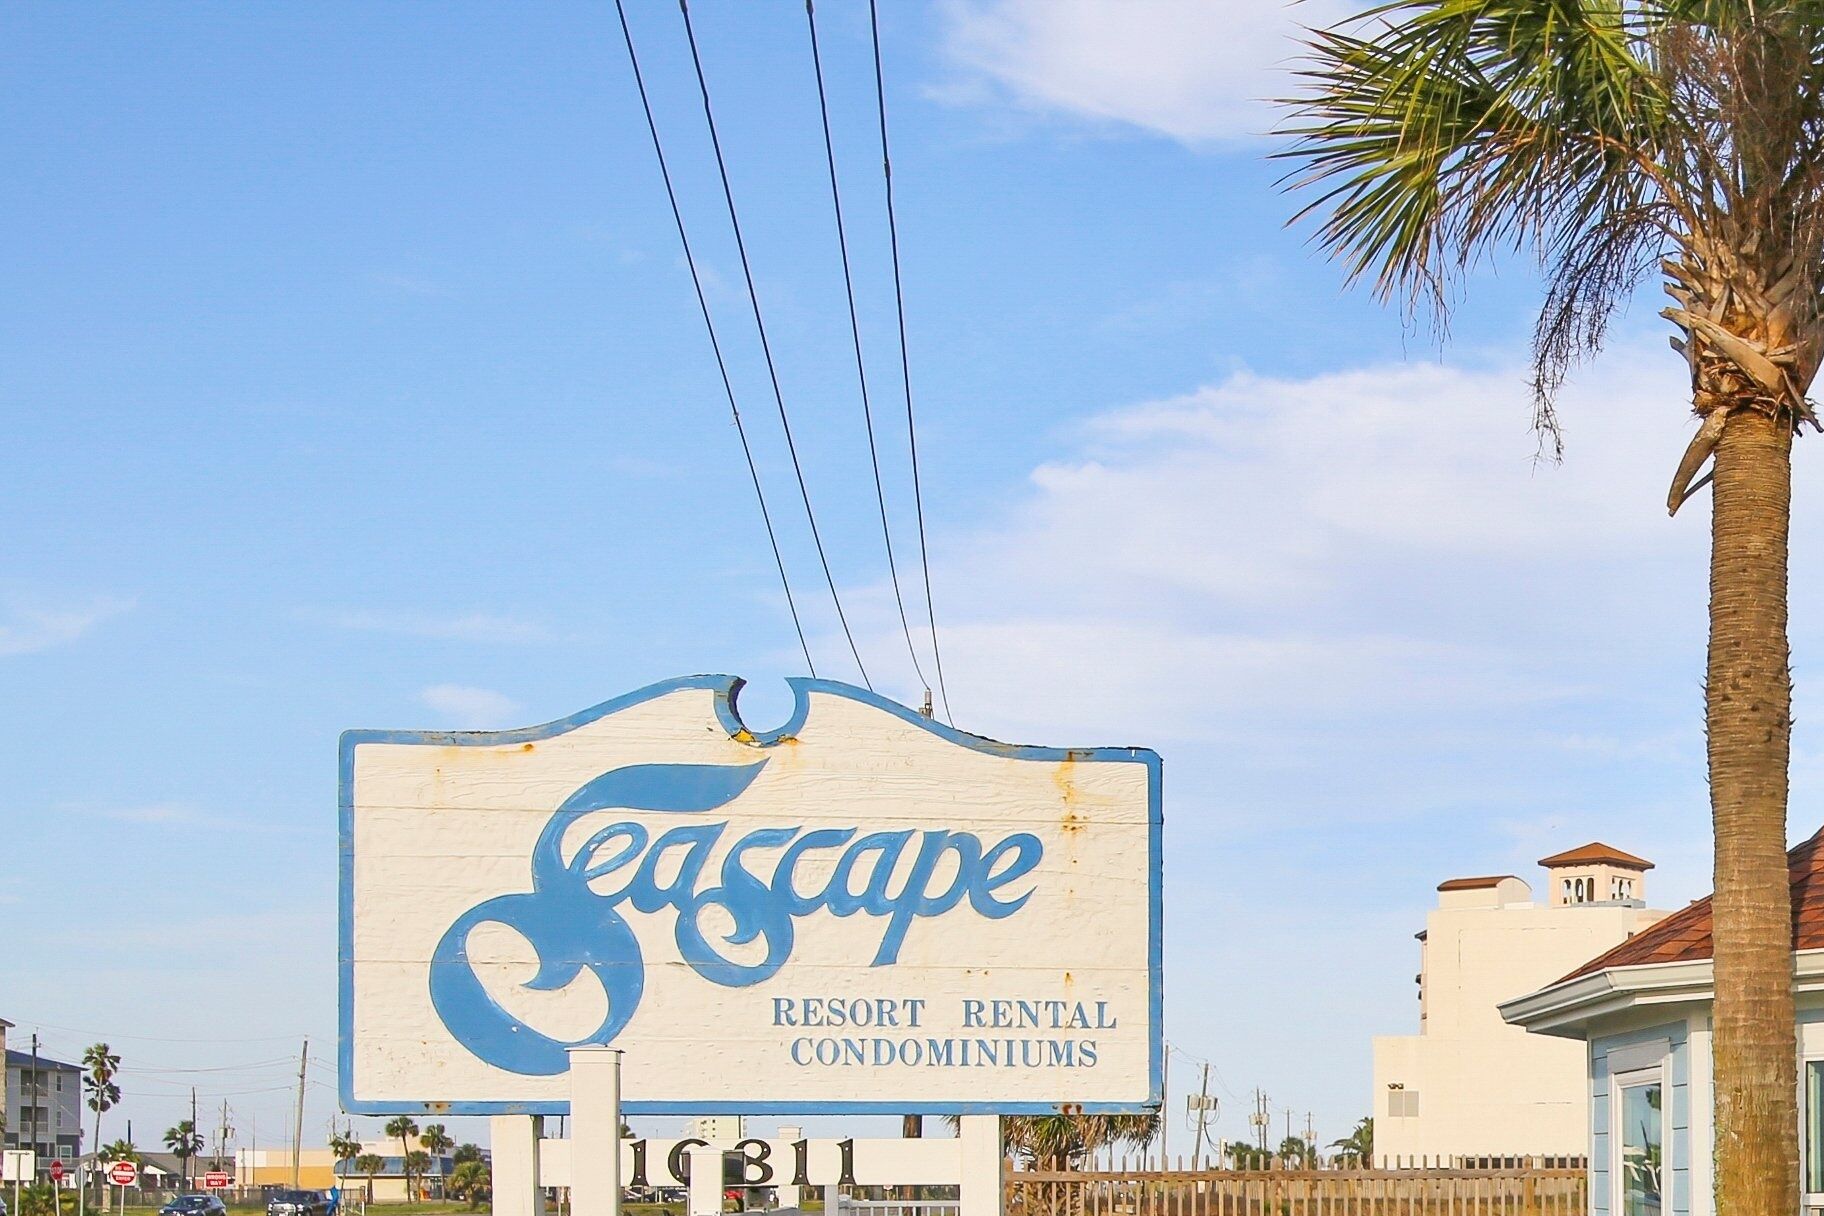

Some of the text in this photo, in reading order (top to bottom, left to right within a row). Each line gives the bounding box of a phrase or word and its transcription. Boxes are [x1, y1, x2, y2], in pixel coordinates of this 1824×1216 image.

[771, 997, 1118, 1030] RESORT RENTAL
[790, 1037, 1099, 1068] CONDOMINIUMS
